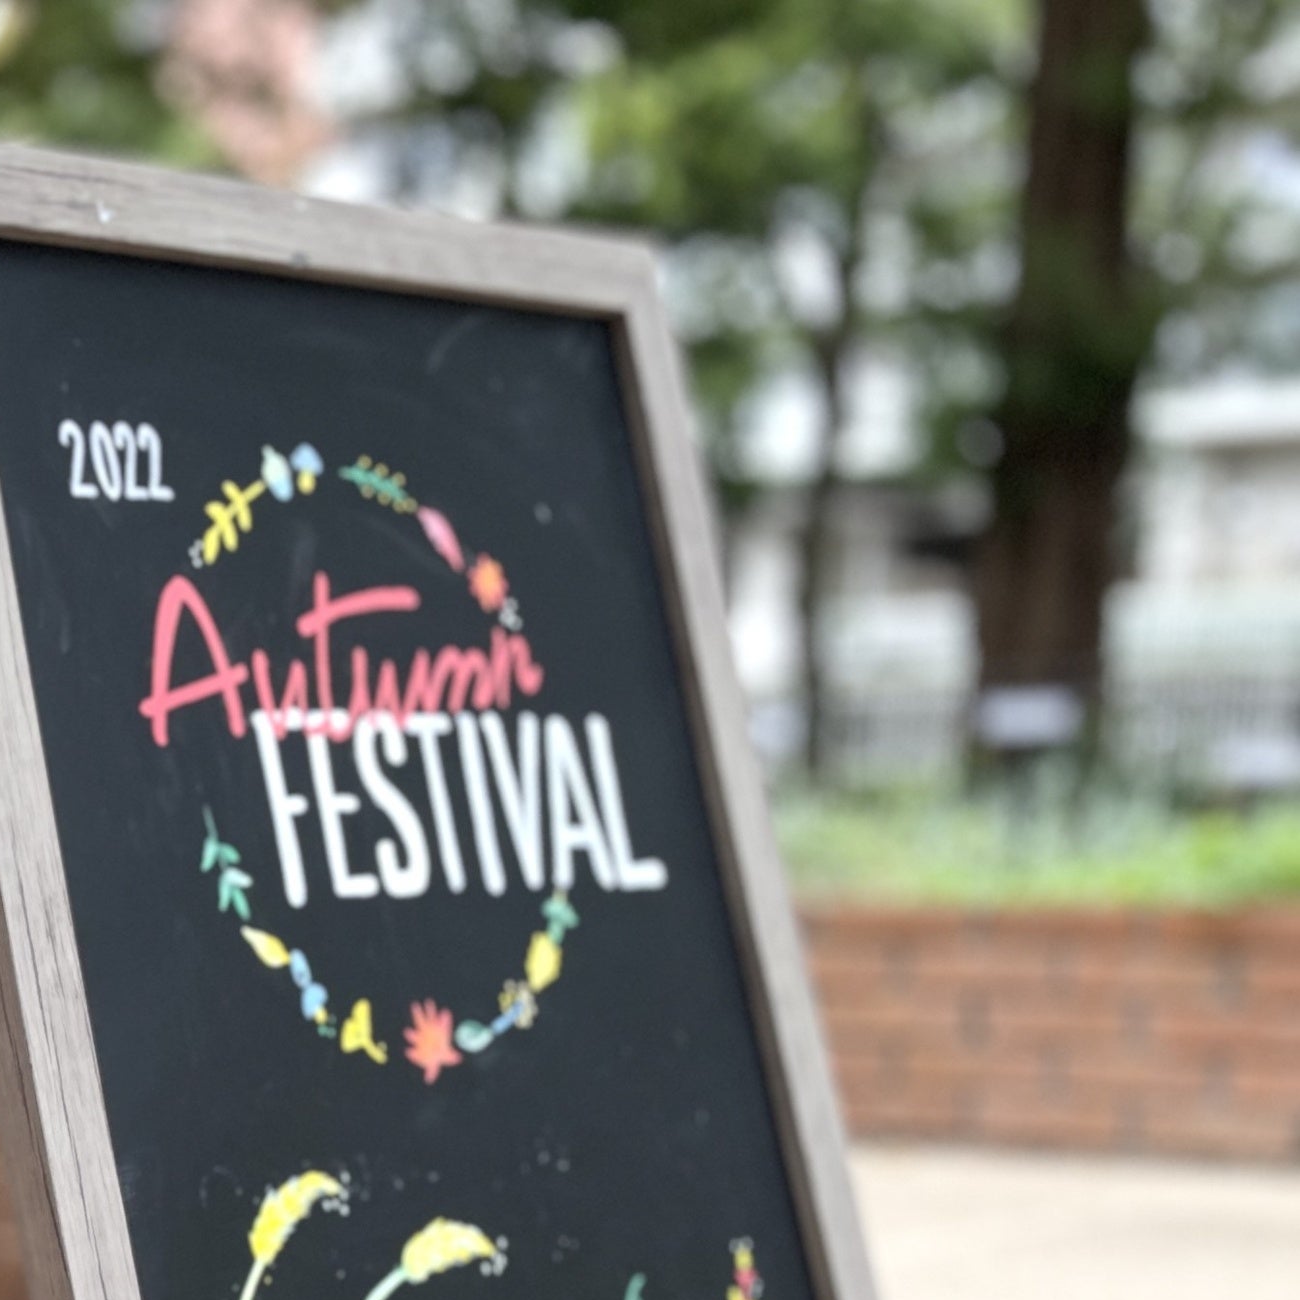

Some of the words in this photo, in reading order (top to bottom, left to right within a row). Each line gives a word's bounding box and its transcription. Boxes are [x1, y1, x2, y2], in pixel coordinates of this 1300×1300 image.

[58, 419, 174, 500] 2022
[139, 571, 542, 747] Autumn
[251, 709, 666, 907] FESTIVAL
